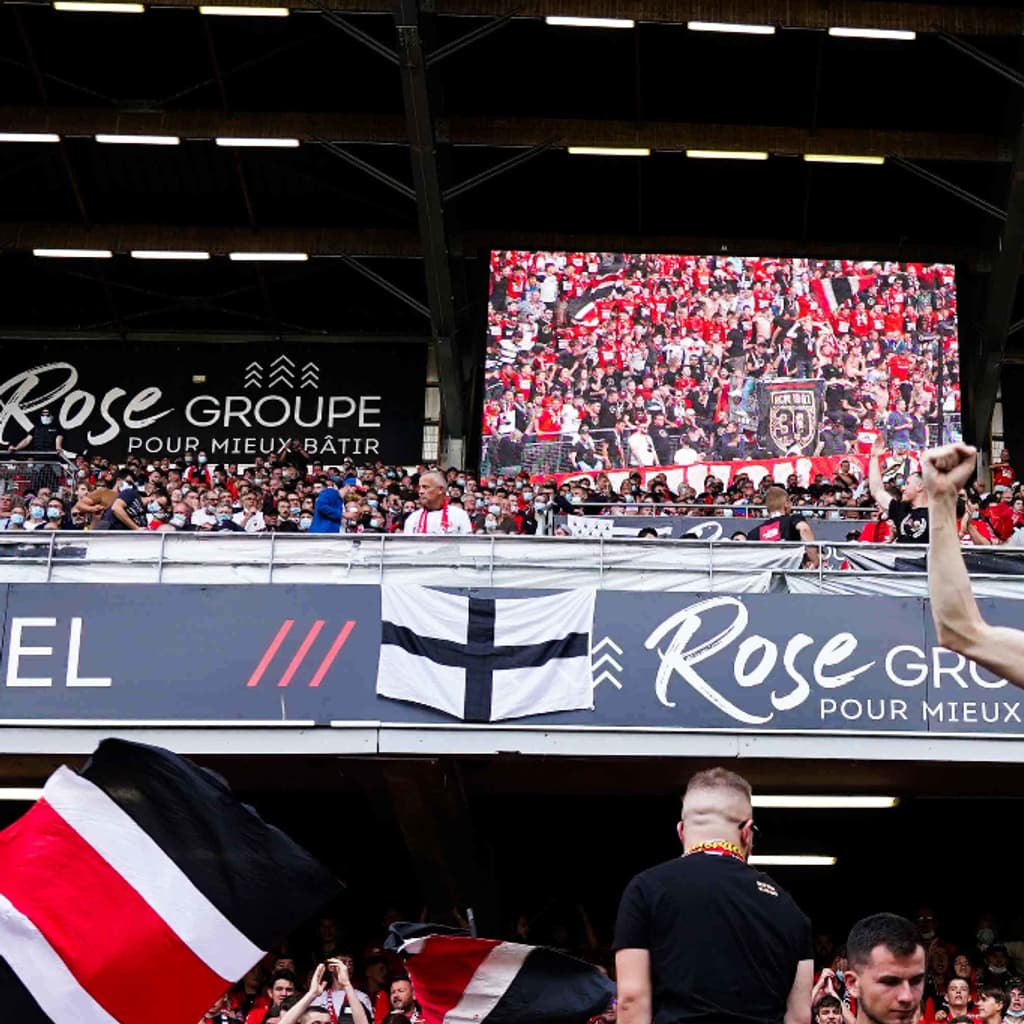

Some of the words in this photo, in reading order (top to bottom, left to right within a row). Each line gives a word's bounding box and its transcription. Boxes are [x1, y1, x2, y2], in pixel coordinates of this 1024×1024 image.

[0, 362, 175, 459] Rose
[185, 395, 382, 428] GROUPE
[129, 437, 200, 454] POUR
[211, 437, 292, 454] MIEUX
[303, 434, 380, 455] BÂTIR
[5, 616, 113, 688] EL
[644, 595, 878, 725] Rose
[821, 698, 908, 721] POUR
[922, 701, 1022, 723] MIEUX
